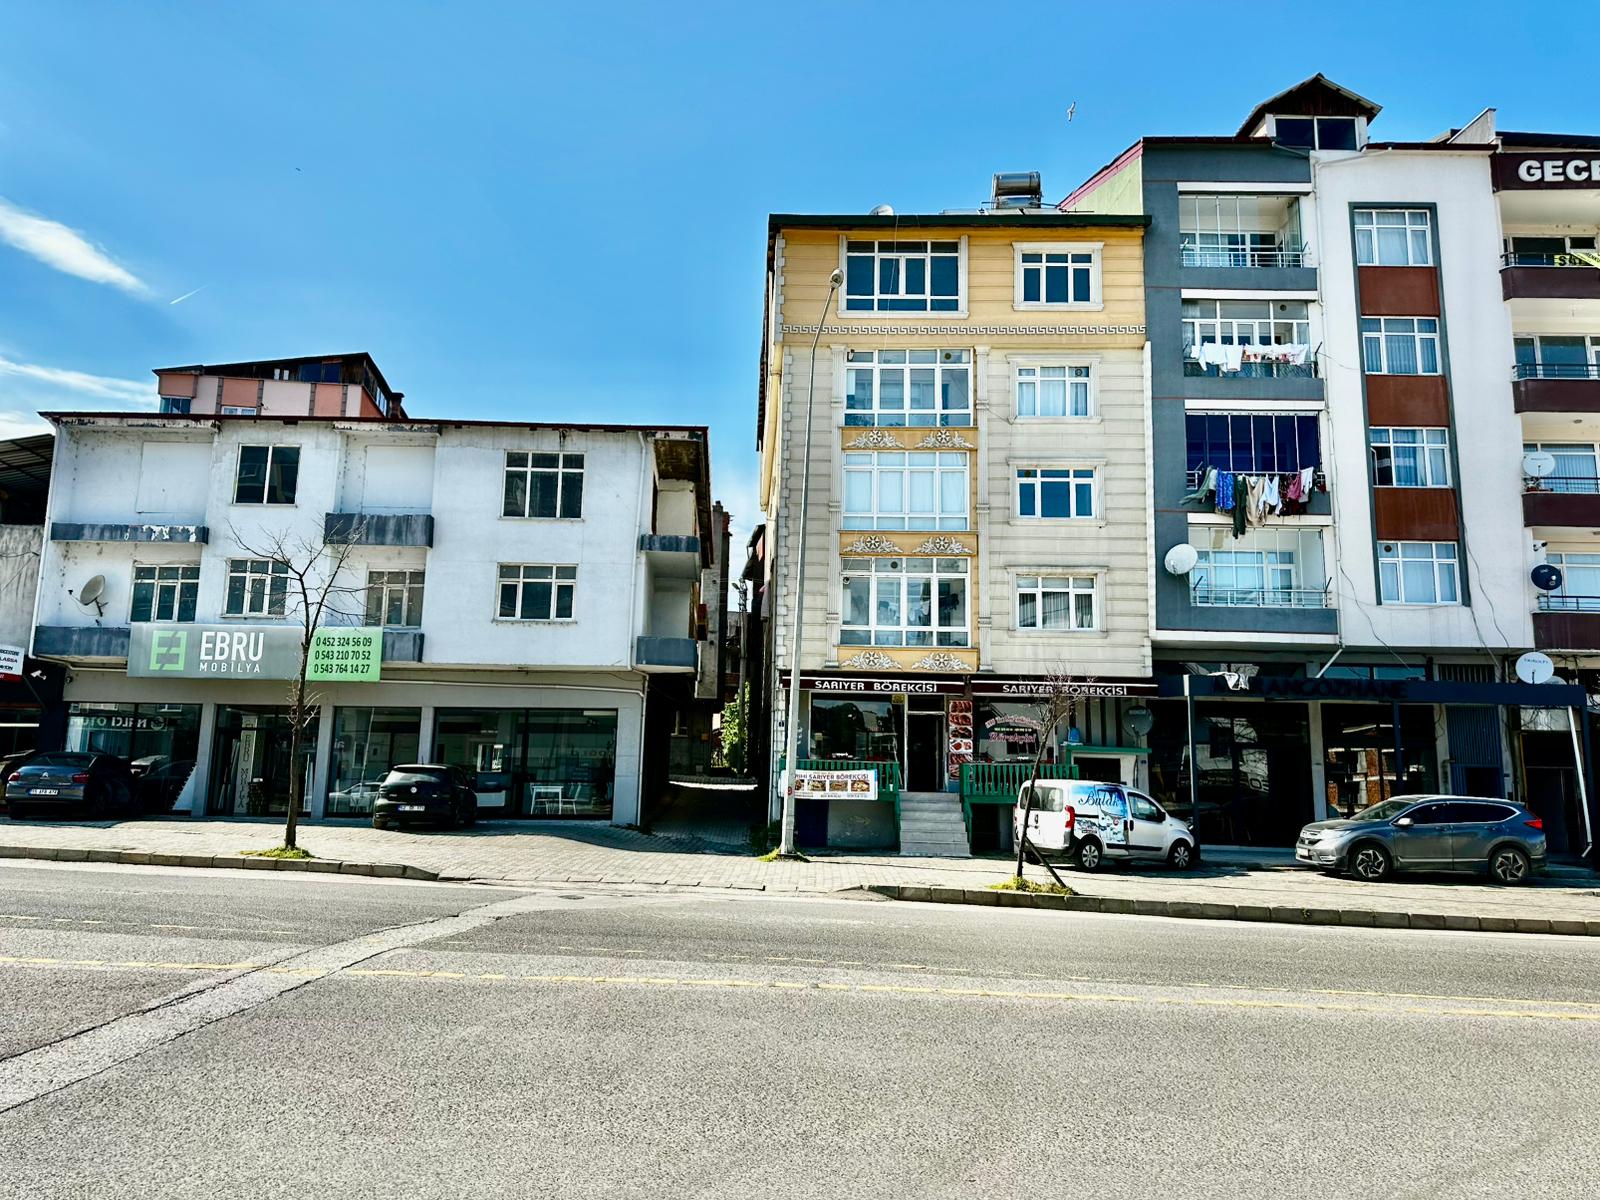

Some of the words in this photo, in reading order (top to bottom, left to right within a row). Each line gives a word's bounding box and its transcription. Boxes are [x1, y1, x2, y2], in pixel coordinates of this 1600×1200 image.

[200, 631, 265, 661] EBRU
[316, 637, 321, 647] 0
[322, 637, 335, 647] 452
[337, 637, 350, 647] 324
[351, 637, 361, 647] 56
[362, 637, 373, 647] 09
[314, 650, 320, 660] 0
[321, 650, 335, 660] 543
[336, 650, 349, 660] 210
[351, 650, 361, 660] 70
[361, 650, 371, 660] 52
[199, 662, 260, 673] MOBİLYA
[313, 663, 319, 673] 0
[320, 663, 334, 674] 543
[335, 664, 348, 674] 764
[350, 664, 359, 674] 14
[360, 664, 371, 674] 27
[814, 680, 865, 691] SARIYER
[1002, 684, 1053, 694] SARIYER
